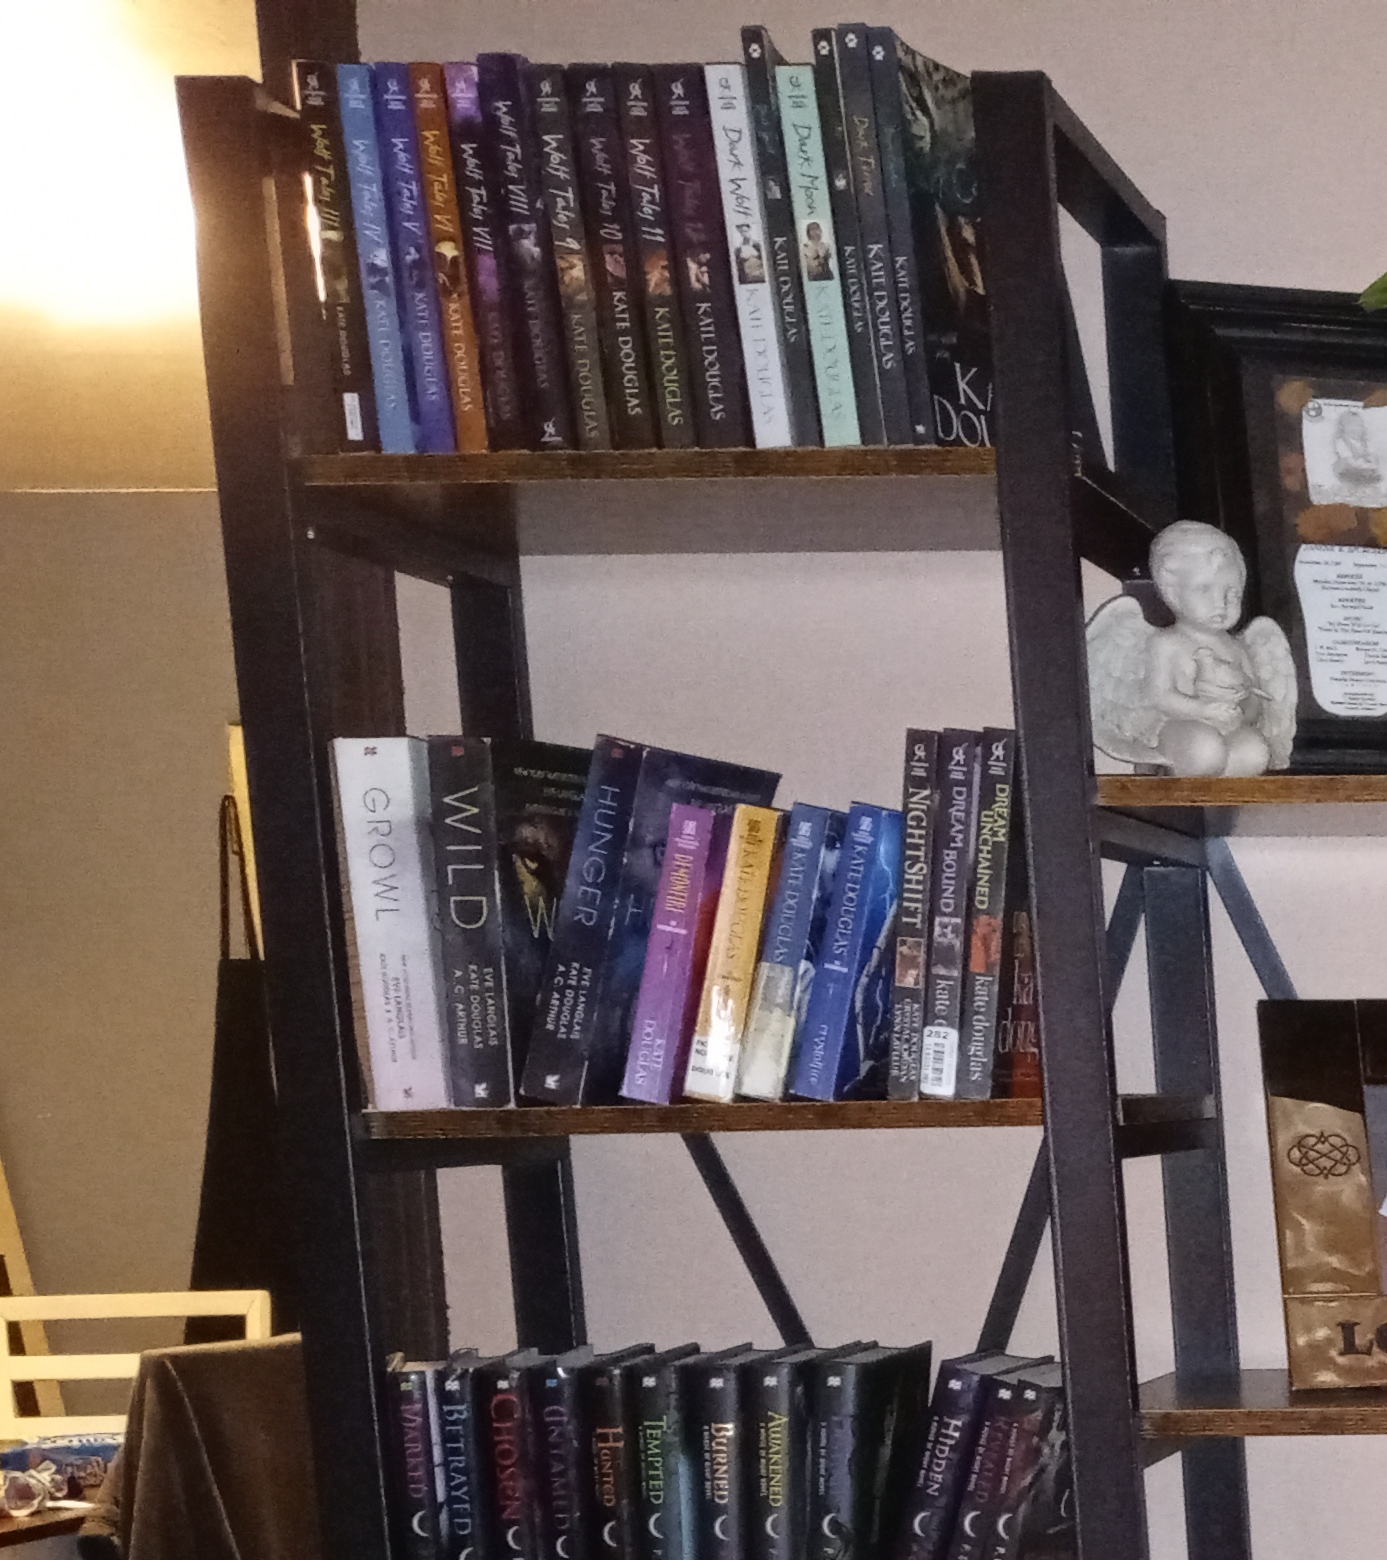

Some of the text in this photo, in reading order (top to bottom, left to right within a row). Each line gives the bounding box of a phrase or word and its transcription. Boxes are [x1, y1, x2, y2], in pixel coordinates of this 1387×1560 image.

[612, 291, 643, 416] KATE DOUGLAS
[654, 307, 684, 426] KATE DOUGLAS
[696, 302, 726, 422] KATE DOUGLAS
[867, 244, 897, 369] KATE DOUGLAS
[362, 787, 400, 921] GROWL
[442, 786, 488, 929] WILD
[573, 785, 621, 927] HUNGER
[904, 786, 931, 929] NIGHTSHIFT
[940, 786, 968, 913] DREAM BOUND
[974, 784, 1010, 910] DREAM UNCHAINED
[968, 975, 993, 1082] kate douglas
[443, 1403, 473, 1535] BETRAYED
[643, 1415, 668, 1505] TEMPTED
[710, 1423, 735, 1505] BURNED
[768, 1410, 789, 1507] AWAKENED
[928, 1416, 963, 1497] HIDDEN
